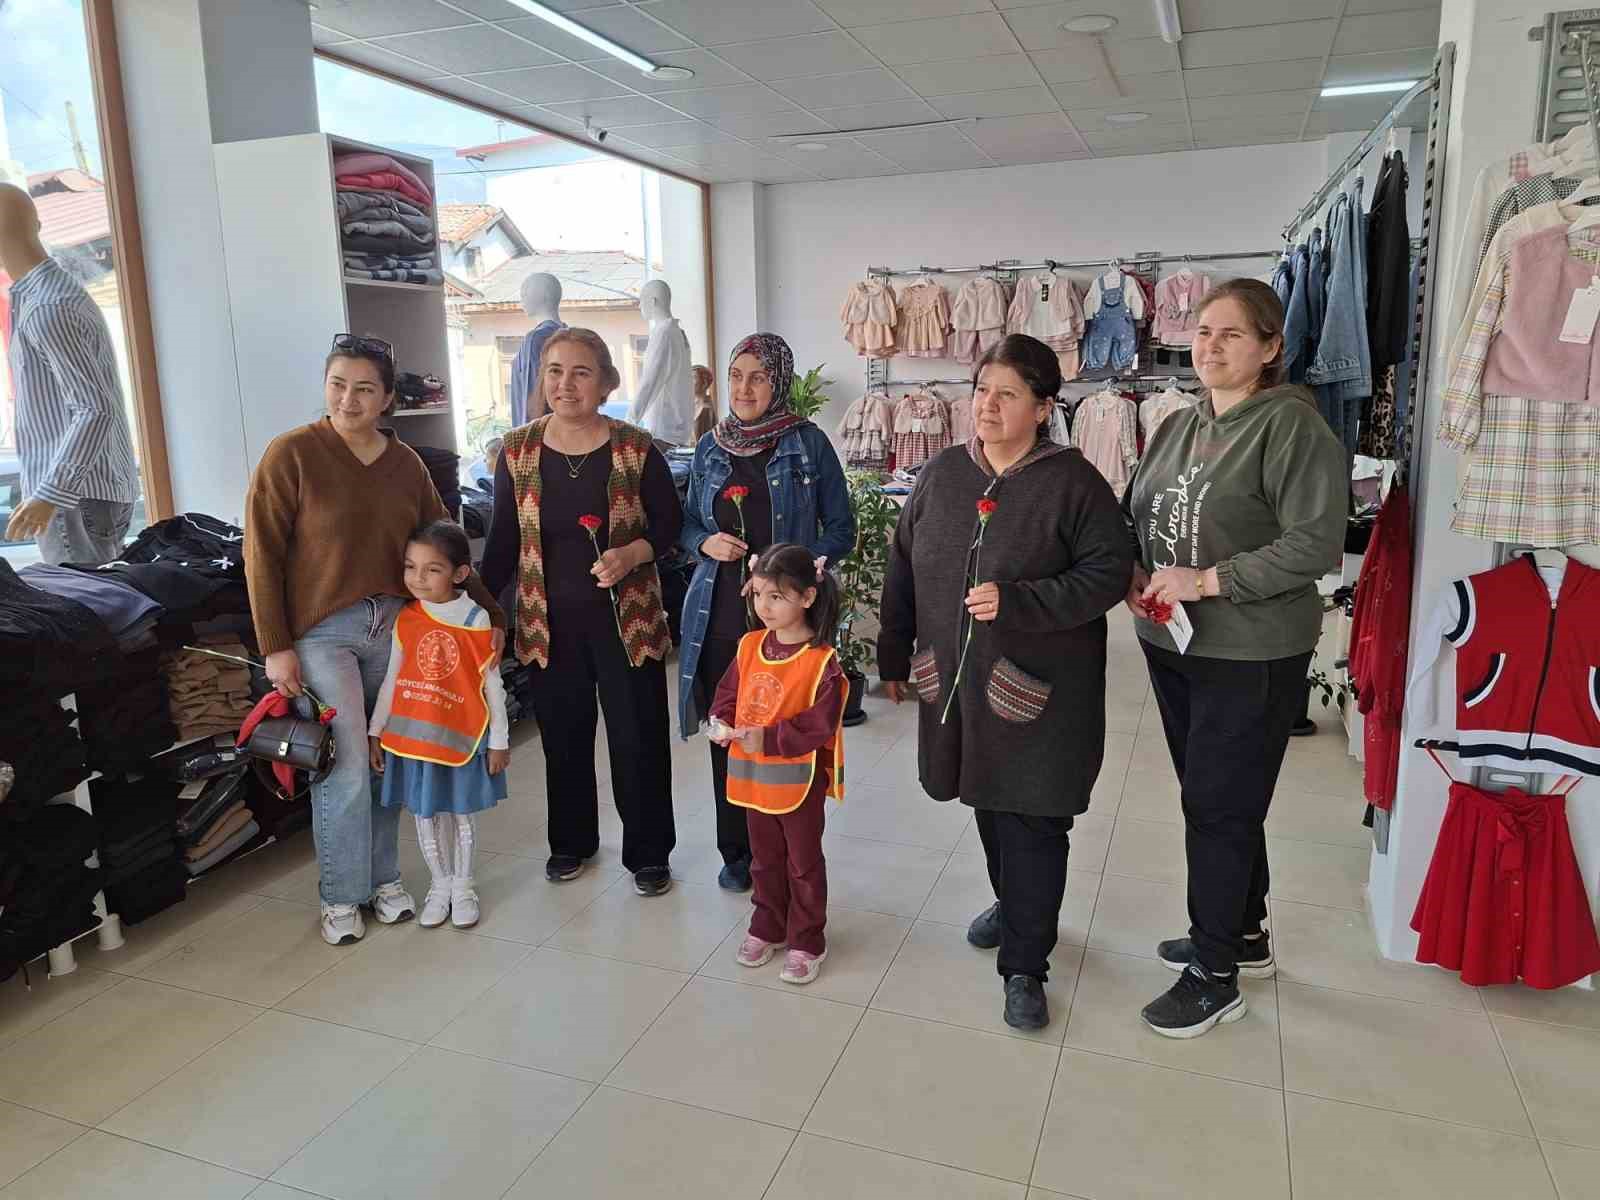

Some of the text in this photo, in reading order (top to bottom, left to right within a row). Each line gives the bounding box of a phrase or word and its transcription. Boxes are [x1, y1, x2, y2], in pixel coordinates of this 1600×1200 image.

[1149, 493, 1165, 540] YOU ARE
[1193, 501, 1202, 515] AND
[1192, 516, 1200, 534] MORE
